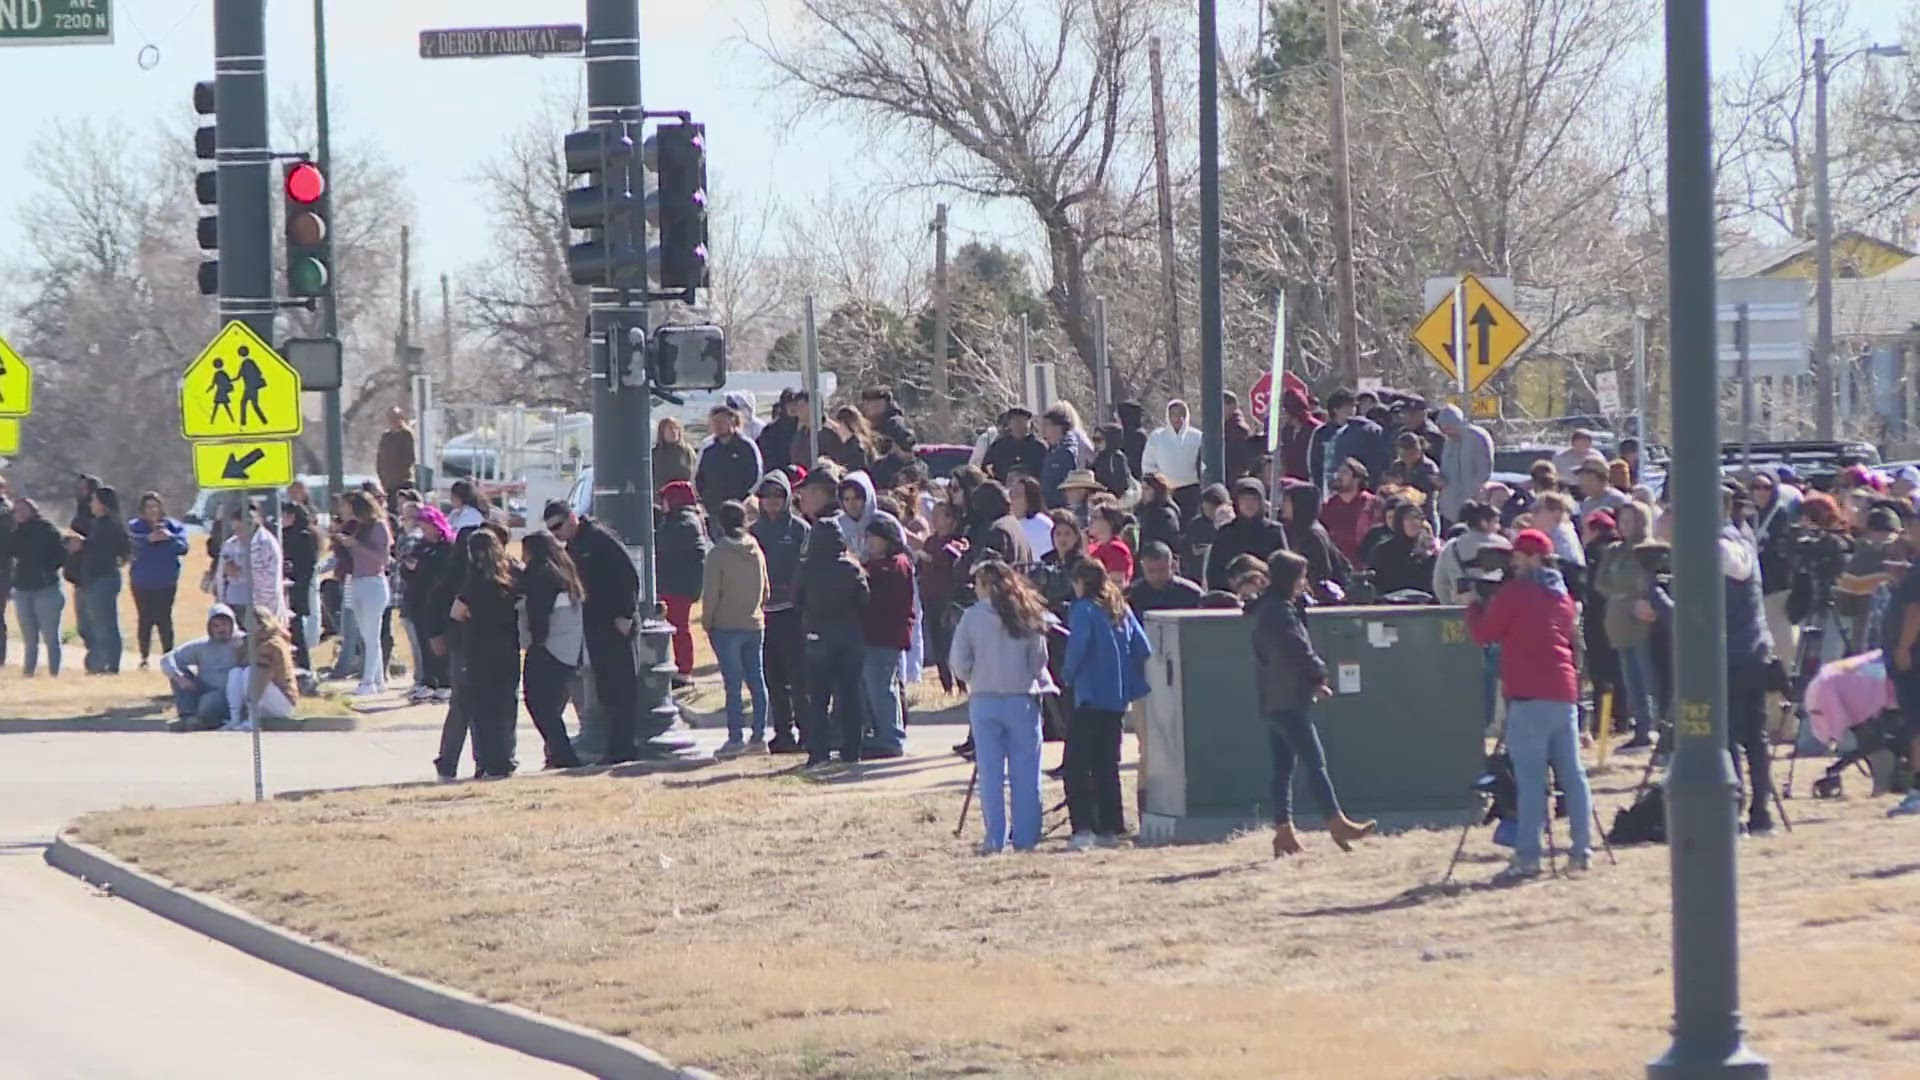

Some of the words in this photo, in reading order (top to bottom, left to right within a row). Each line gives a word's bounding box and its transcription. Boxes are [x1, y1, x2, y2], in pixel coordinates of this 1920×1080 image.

[0, 0, 43, 29] ND
[69, 0, 96, 8] AVE
[54, 13, 92, 29] 7200
[96, 13, 106, 29] N
[438, 31, 486, 55] DERBY
[489, 28, 558, 53] PARKWAY
